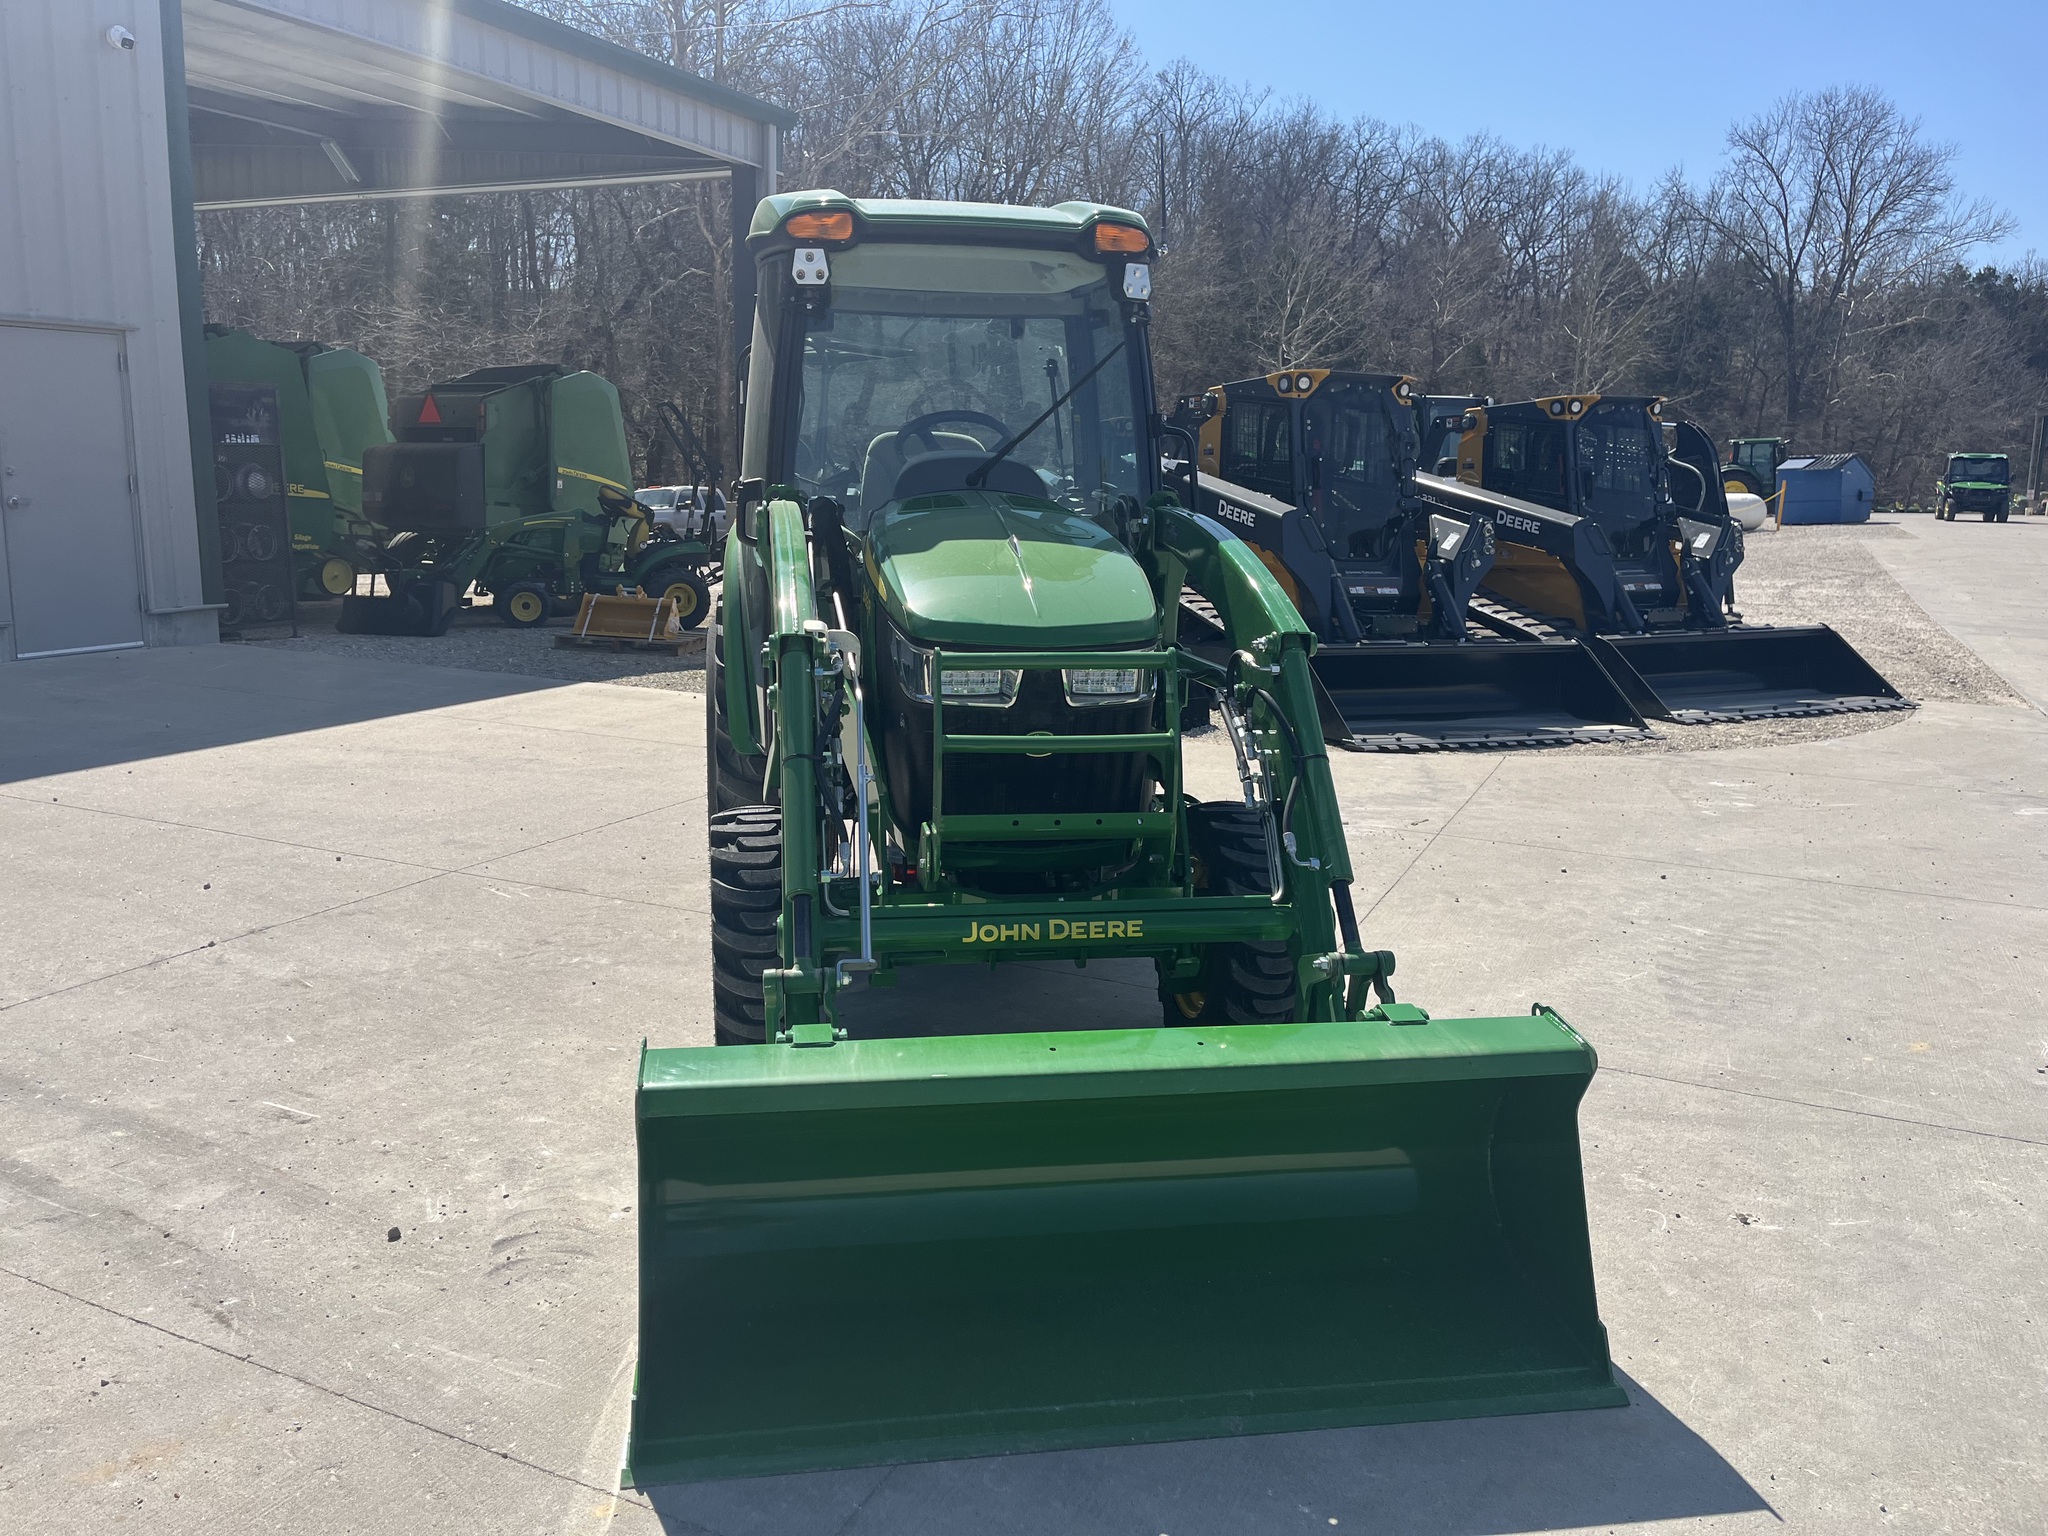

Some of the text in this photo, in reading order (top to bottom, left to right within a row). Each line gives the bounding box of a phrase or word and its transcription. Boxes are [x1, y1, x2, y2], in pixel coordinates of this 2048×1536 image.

[1218, 499, 1256, 528] DEERE
[1496, 509, 1541, 535] DEERE
[962, 919, 1143, 943] JOHN DEERE
